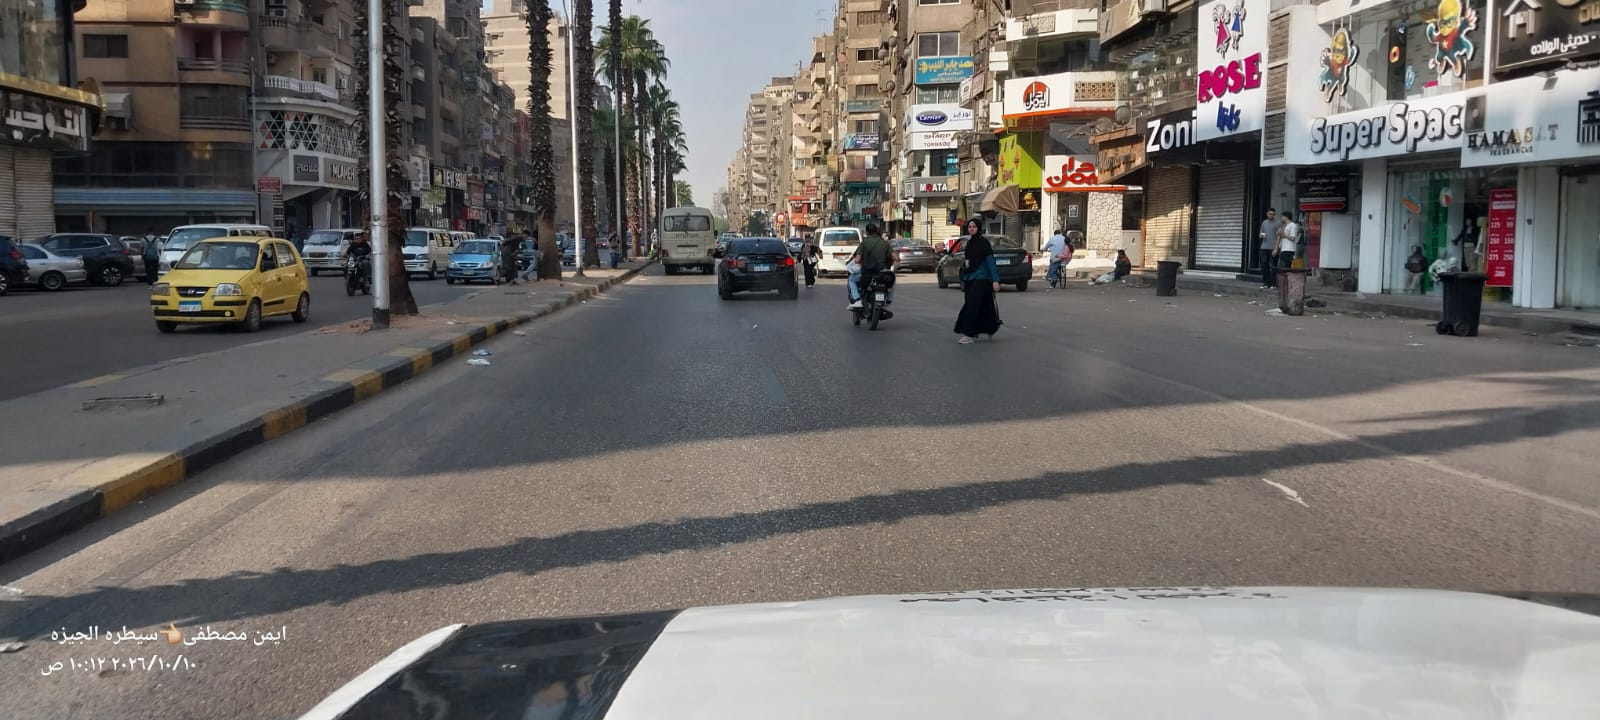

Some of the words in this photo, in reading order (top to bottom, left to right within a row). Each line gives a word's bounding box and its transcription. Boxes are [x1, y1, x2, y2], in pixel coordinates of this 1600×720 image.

[1198, 52, 1262, 103] ROSE
[1146, 110, 1197, 153] Zoni
[1310, 117, 1385, 160] Super
[1388, 101, 1464, 152] Spac
